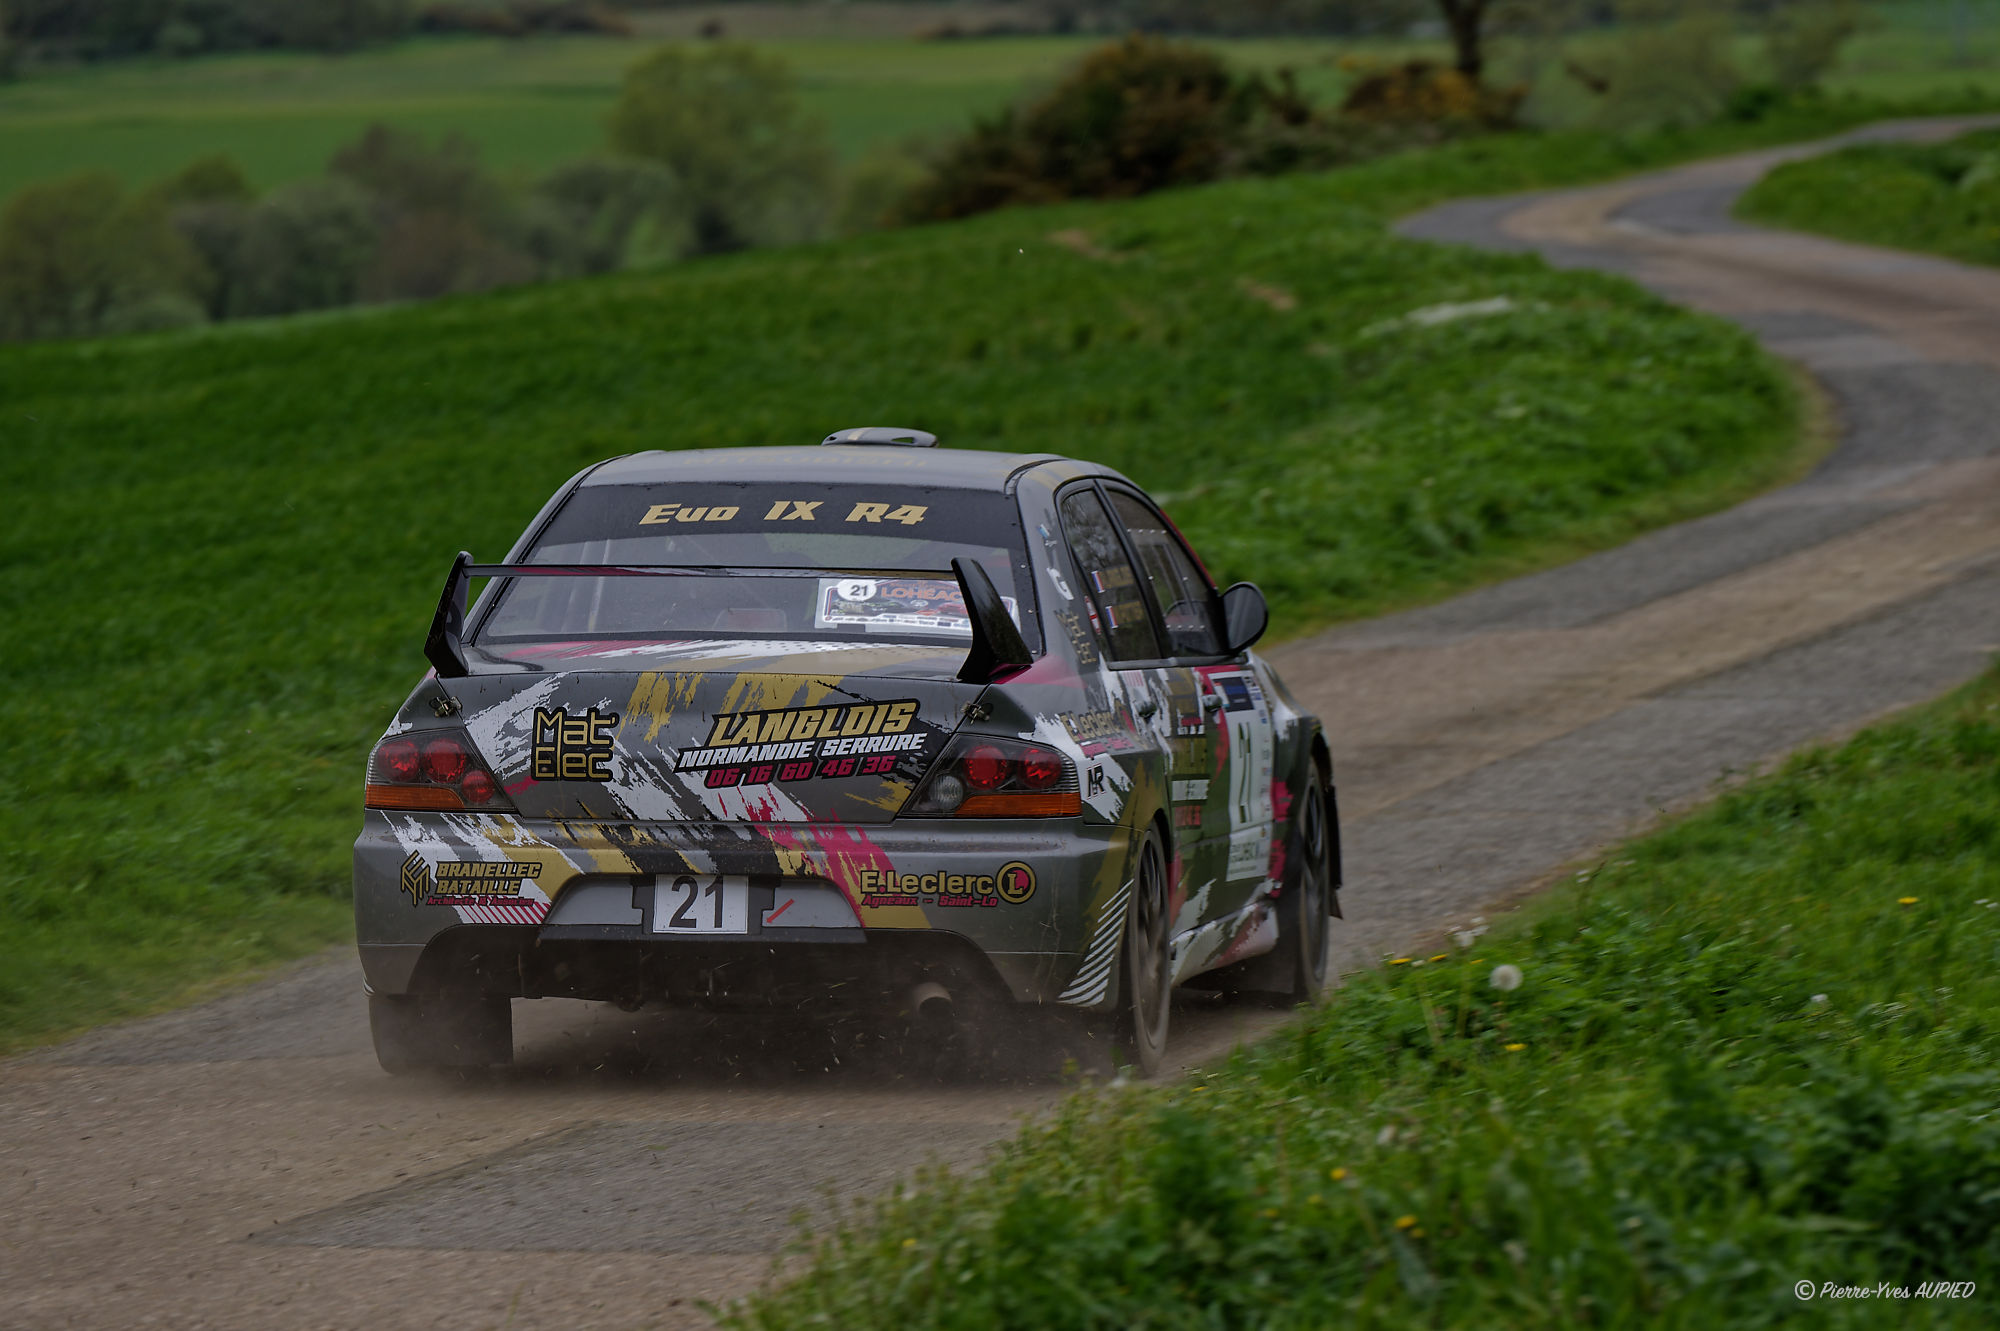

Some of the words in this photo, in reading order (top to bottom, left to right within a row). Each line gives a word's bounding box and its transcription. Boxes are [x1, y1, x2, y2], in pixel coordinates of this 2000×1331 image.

[639, 503, 739, 525] Evo
[763, 501, 824, 521] IX
[845, 502, 928, 525] R4
[850, 584, 868, 597] 21
[708, 702, 918, 747] LANGLOIS
[679, 741, 815, 769] NORMANDIE
[821, 732, 928, 757] SERRURE
[707, 767, 739, 787] 06
[748, 763, 773, 784] 16
[781, 761, 813, 781] 60
[821, 758, 853, 777] 46
[862, 755, 897, 774] 36
[438, 863, 541, 878] BRANELLEC
[438, 880, 521, 894] BATAILLE
[861, 871, 993, 894] E.Leclerc
[669, 876, 724, 929] 21
[863, 895, 918, 907] Agneaux
